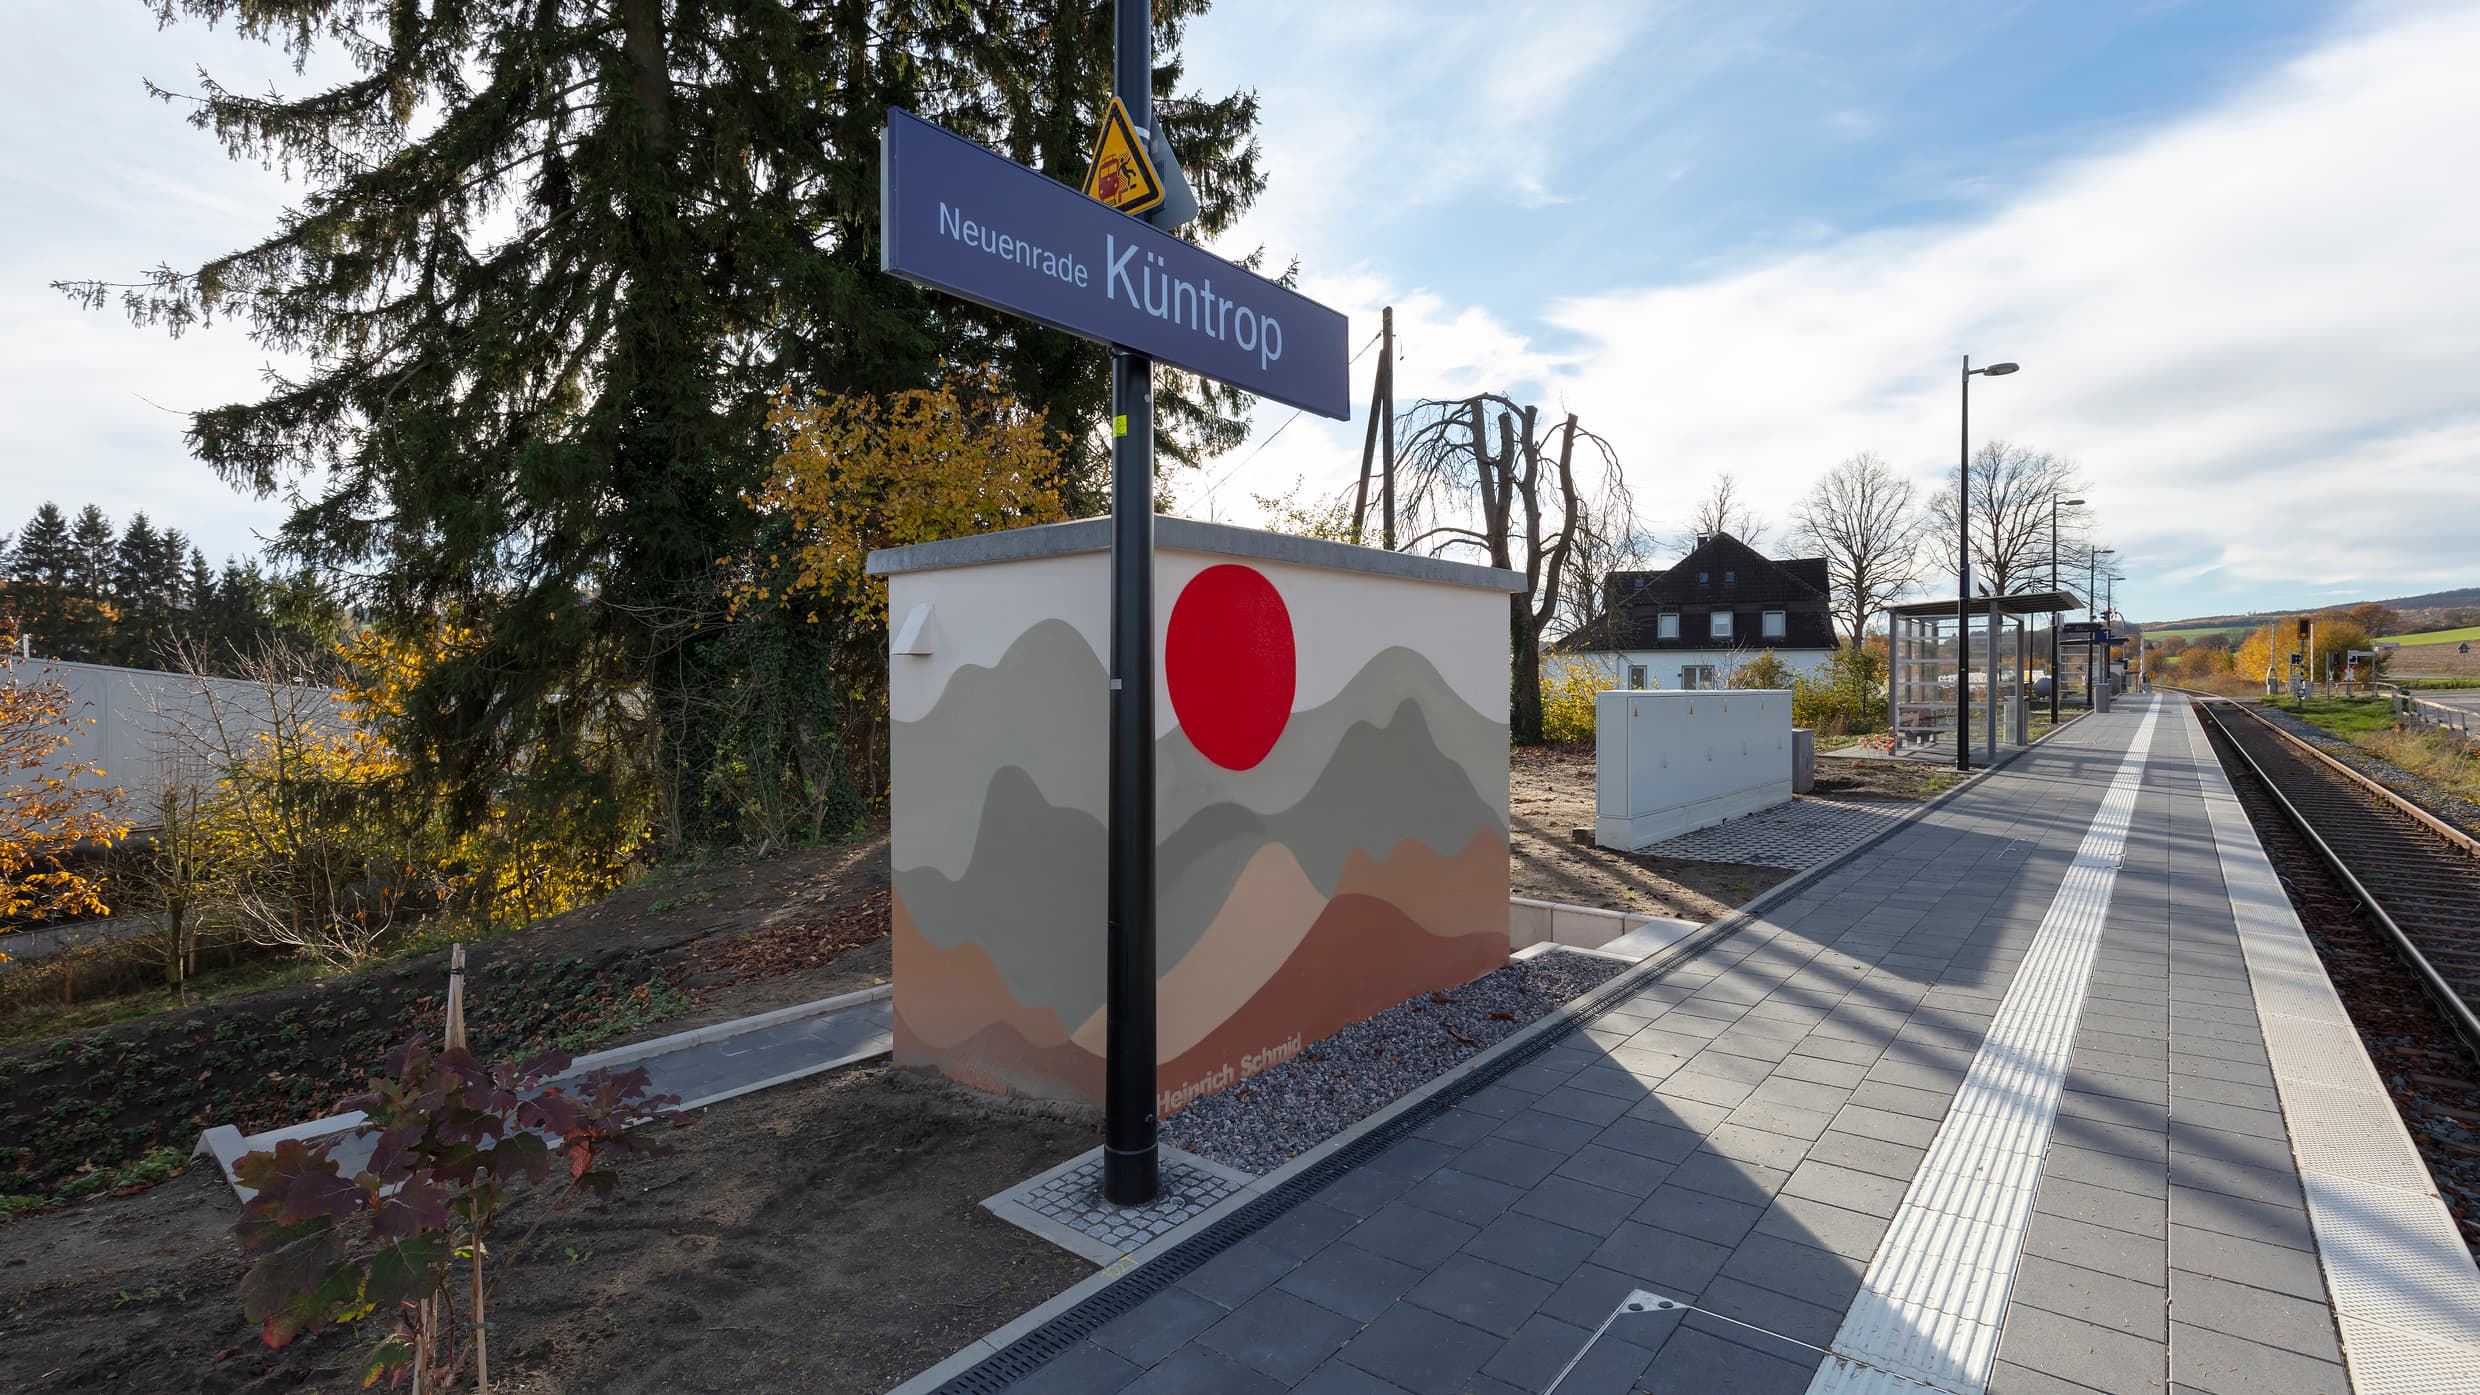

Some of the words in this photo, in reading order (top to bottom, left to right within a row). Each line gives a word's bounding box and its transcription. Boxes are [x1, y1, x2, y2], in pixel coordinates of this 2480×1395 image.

[939, 201, 1088, 288] Neuenrade
[1106, 233, 1283, 371] Küntrop
[2104, 631, 2109, 640] 1
[1156, 1063, 1235, 1116] Heinrich
[1240, 1032, 1302, 1077] Schmid
